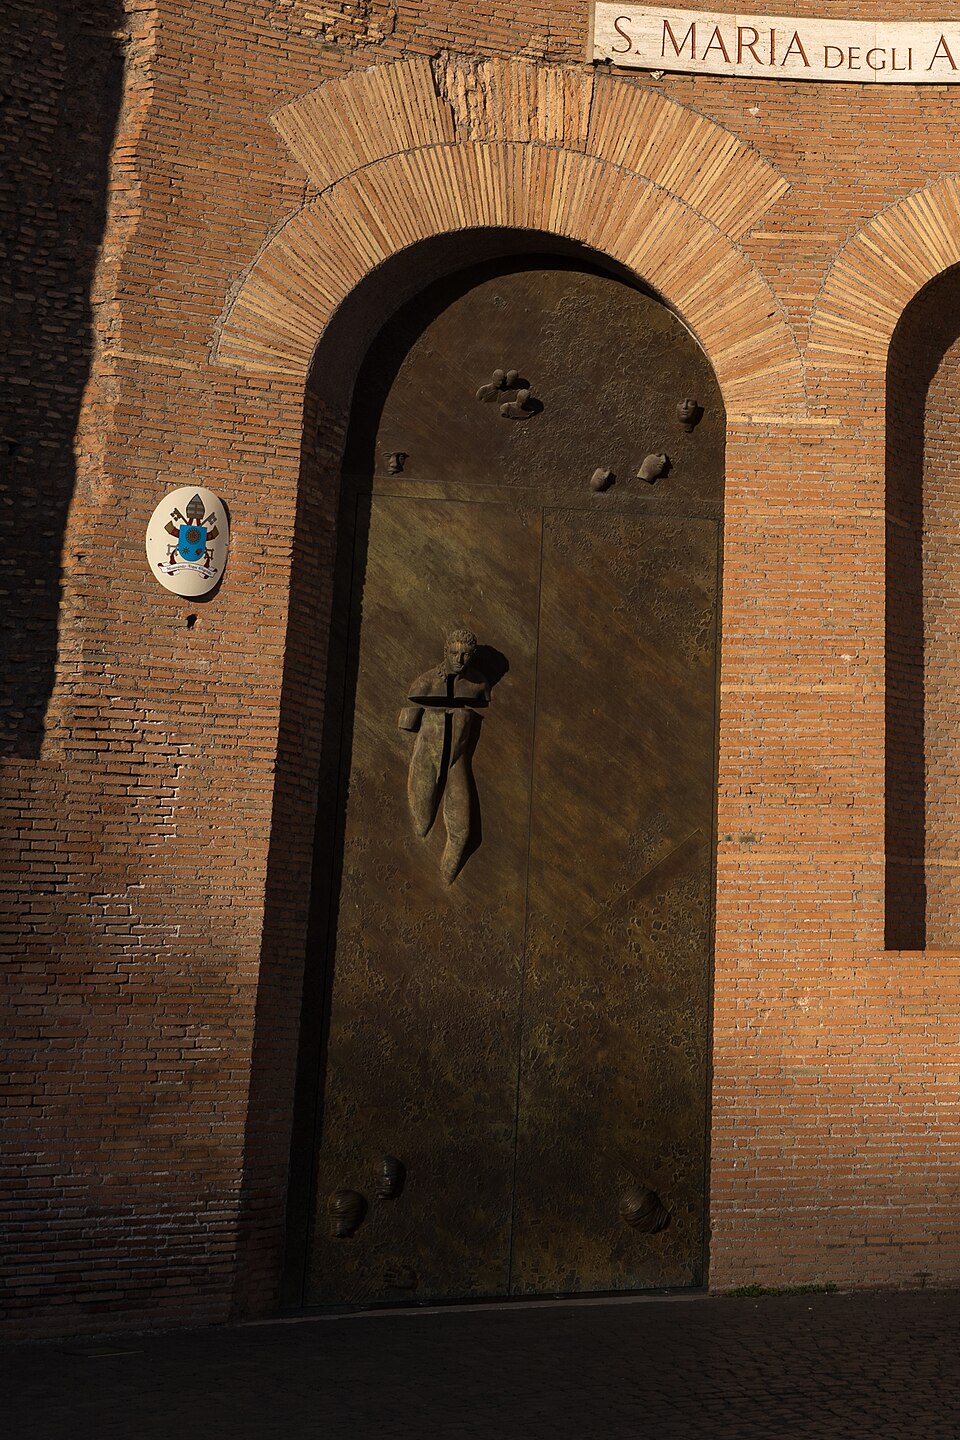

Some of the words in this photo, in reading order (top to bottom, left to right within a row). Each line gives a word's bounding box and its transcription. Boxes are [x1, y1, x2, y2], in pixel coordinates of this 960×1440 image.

[612, 15, 642, 56] S.
[660, 19, 812, 68] MARIA
[823, 45, 914, 72] DEGLI
